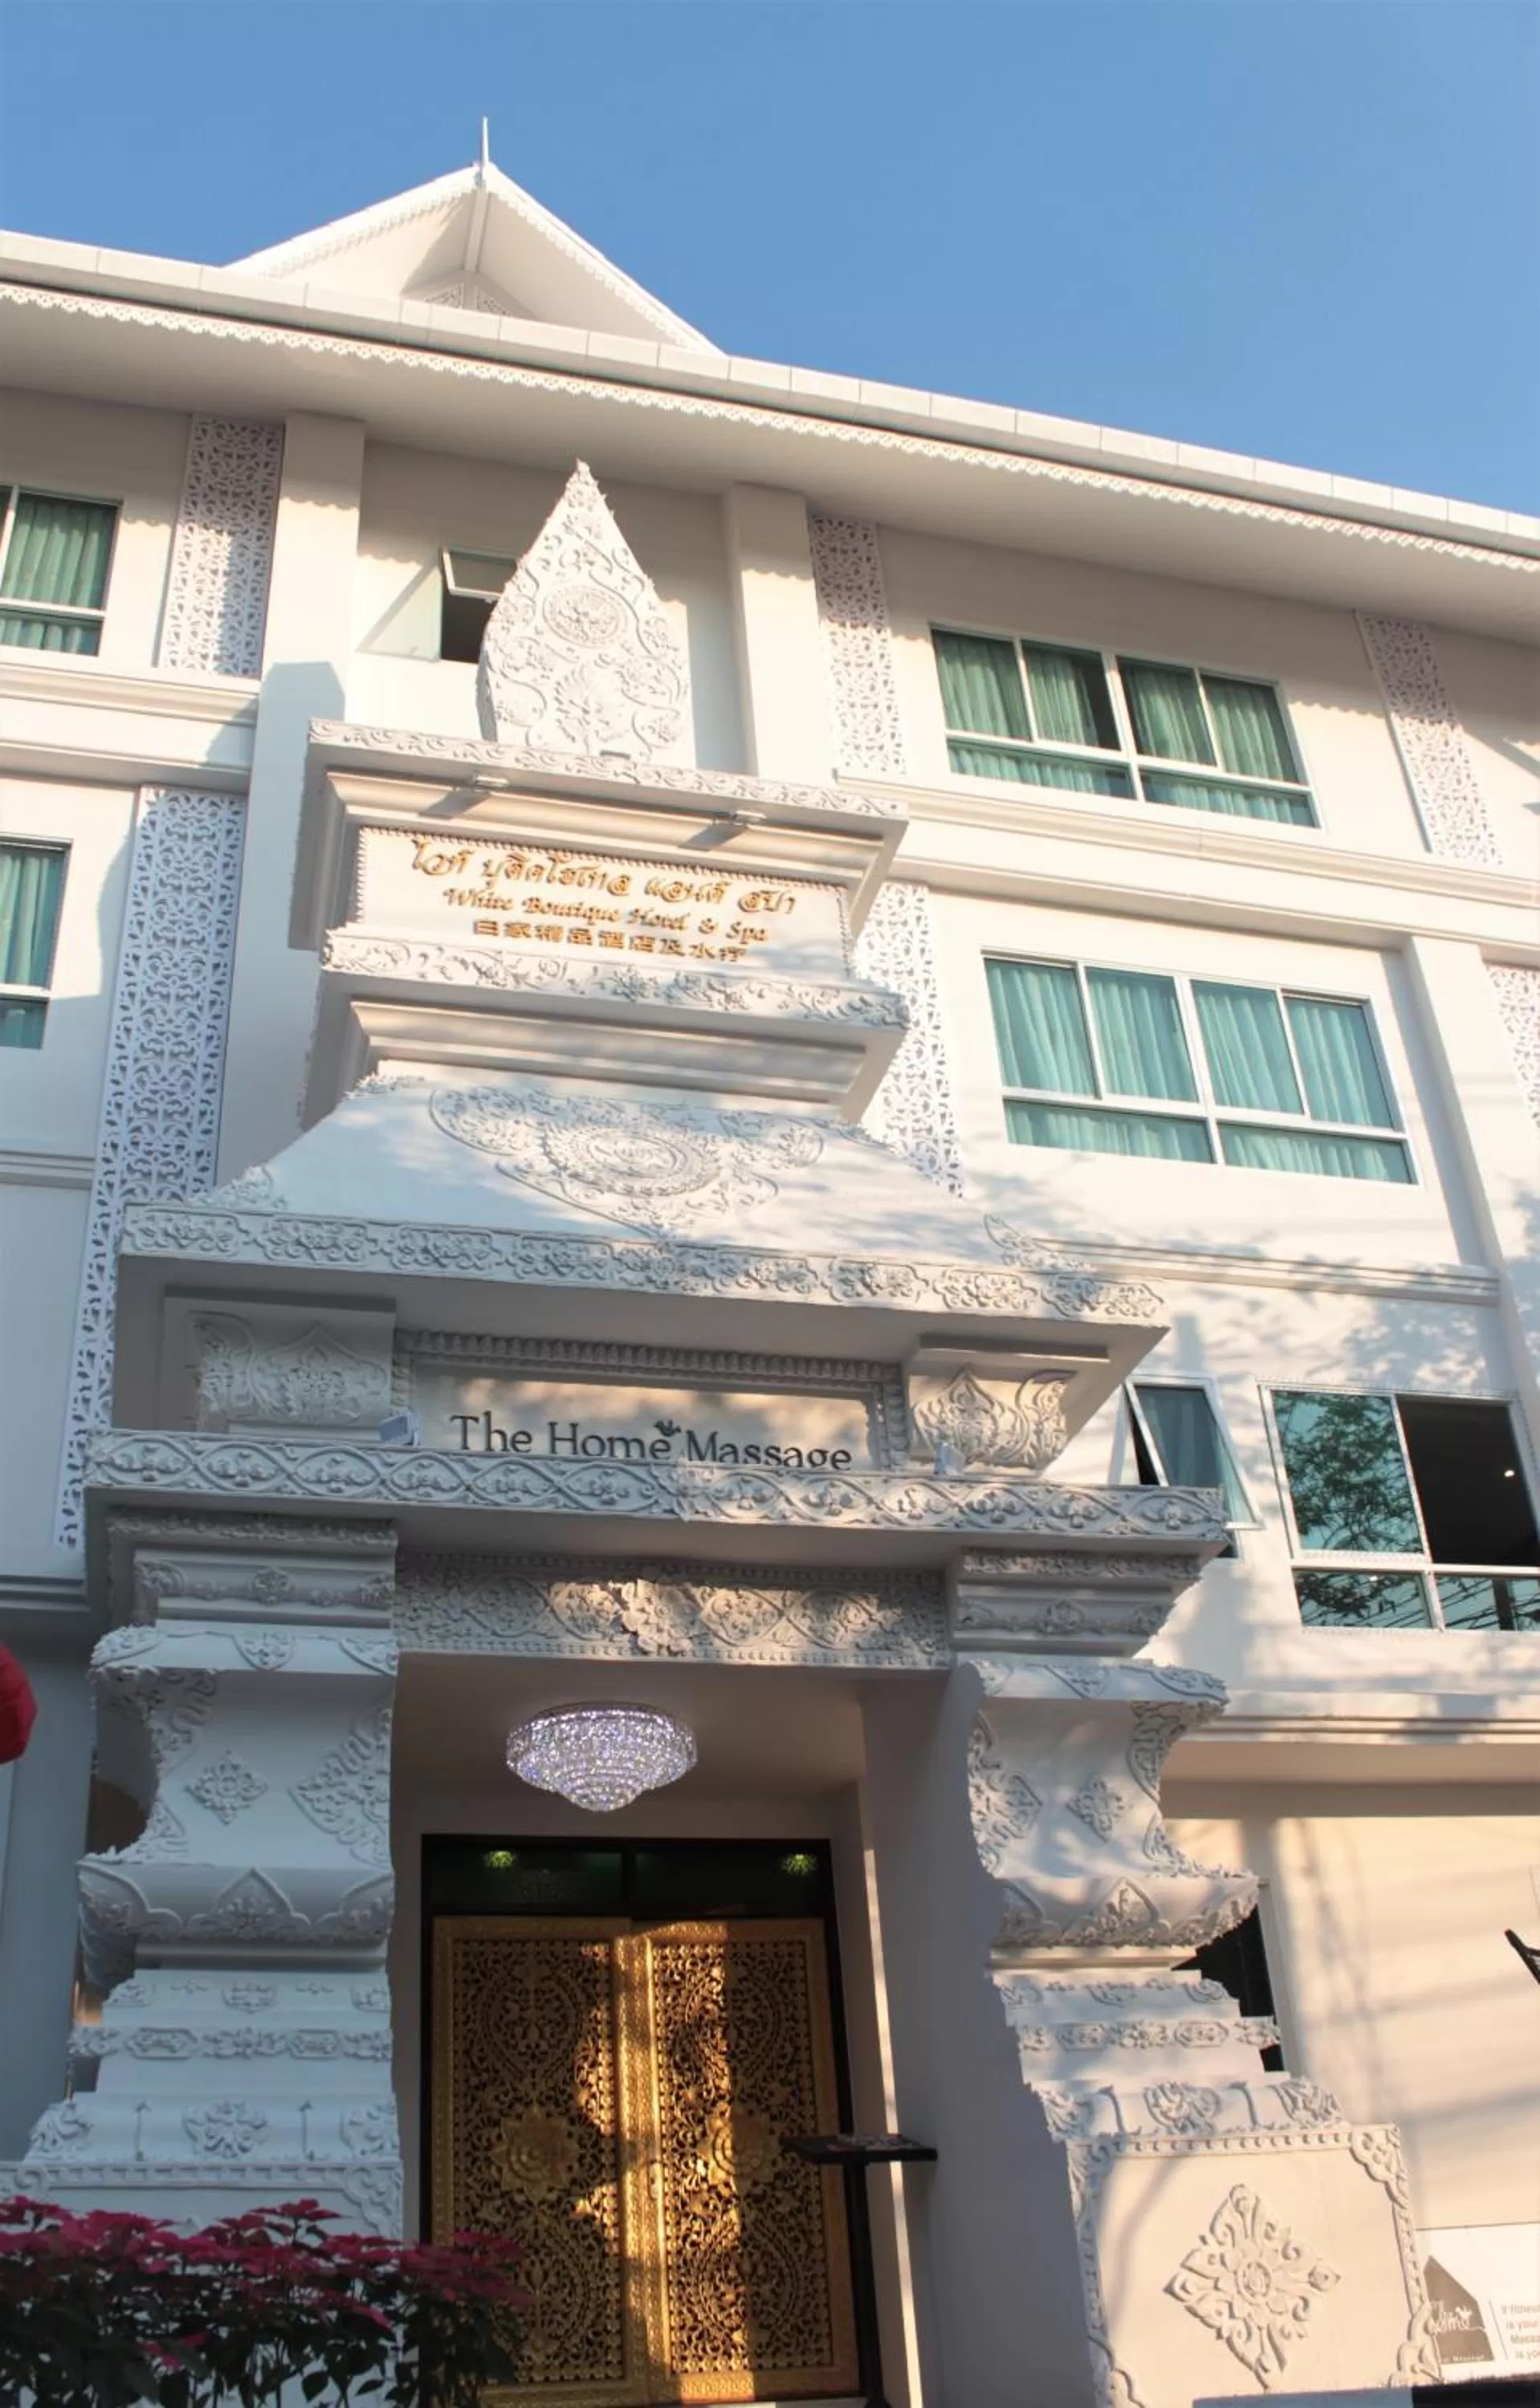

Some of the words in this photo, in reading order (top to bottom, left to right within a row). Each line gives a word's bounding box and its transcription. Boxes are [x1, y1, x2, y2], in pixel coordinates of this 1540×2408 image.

[442, 888, 514, 911] White
[521, 896, 621, 925] Boutique
[626, 907, 691, 931] Hotel
[697, 917, 719, 934] &
[725, 921, 770, 945] Spa
[450, 1410, 533, 1454] The
[547, 1421, 671, 1460] Home
